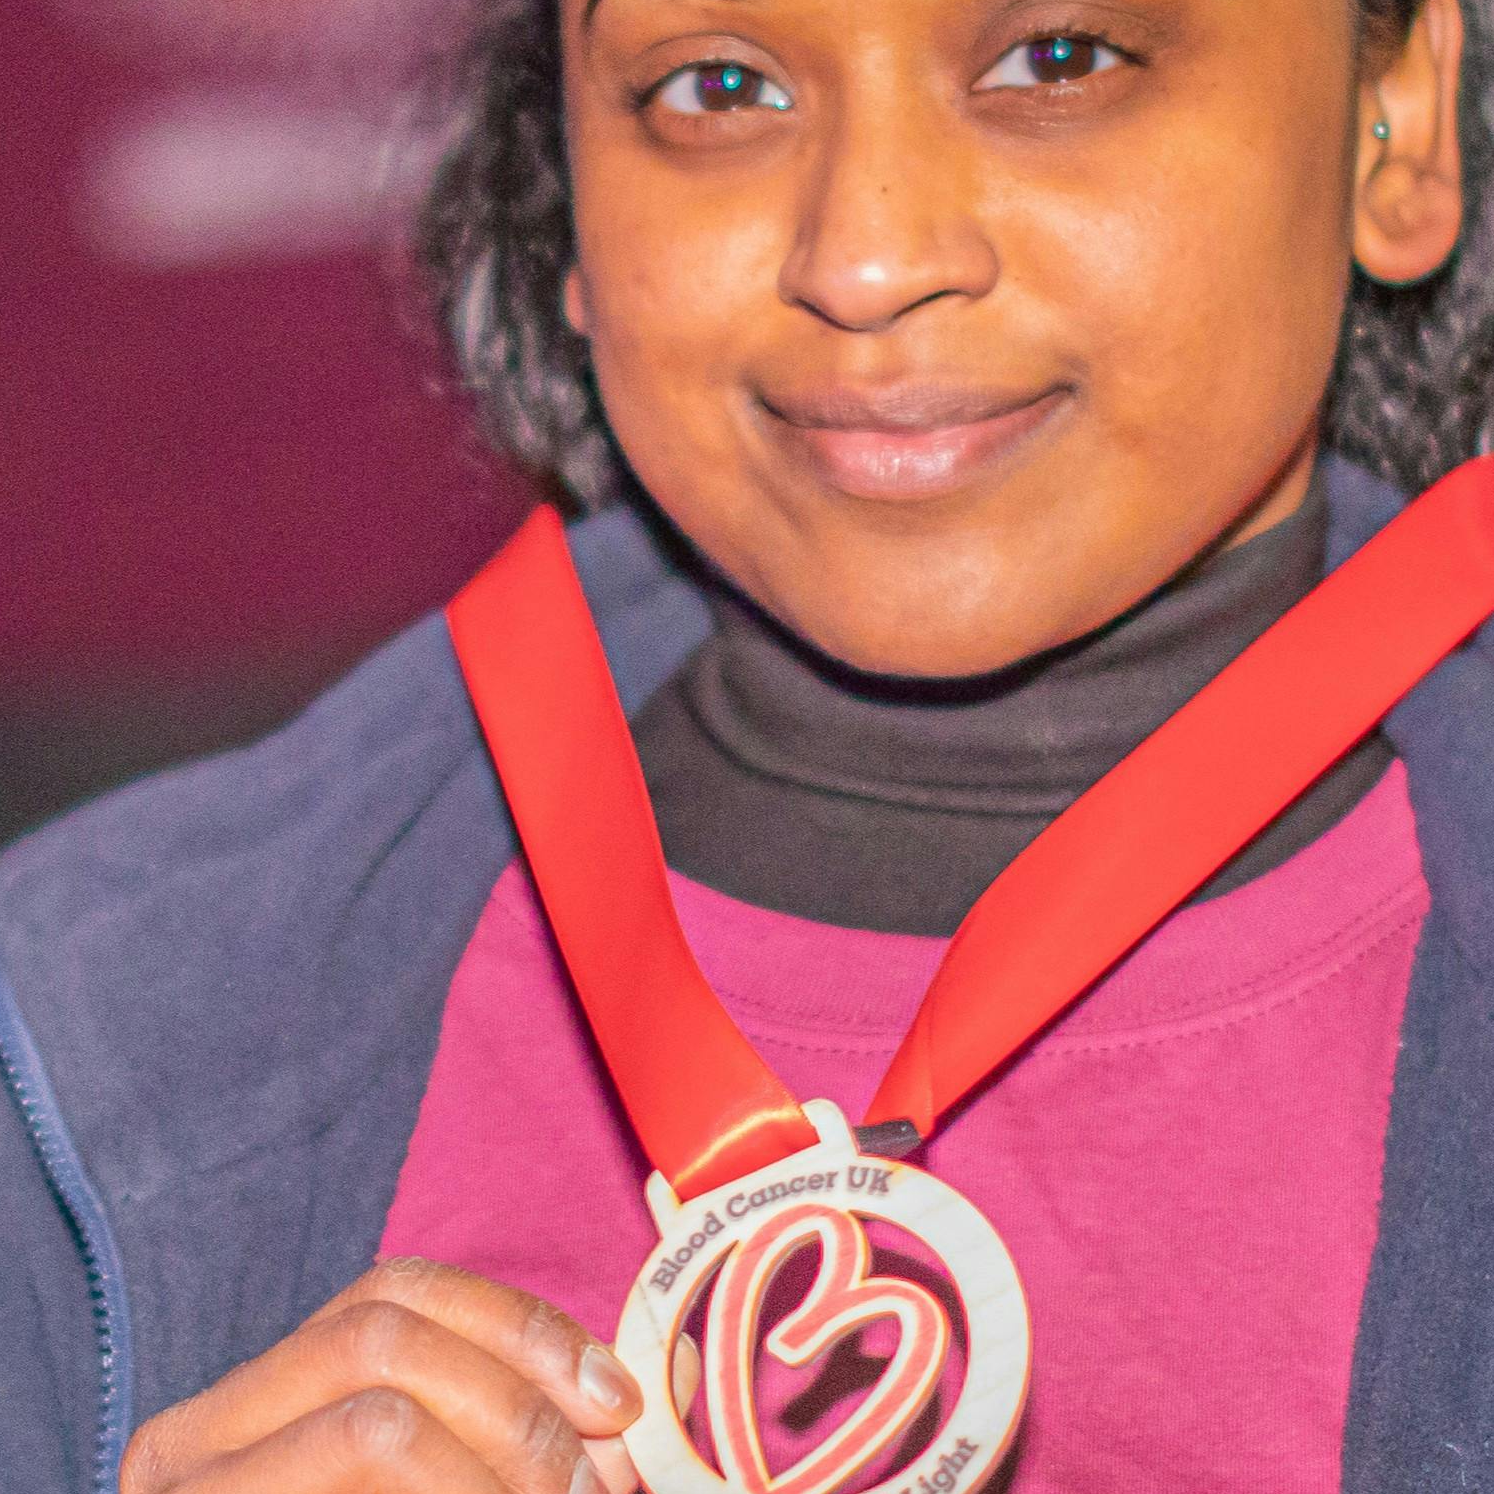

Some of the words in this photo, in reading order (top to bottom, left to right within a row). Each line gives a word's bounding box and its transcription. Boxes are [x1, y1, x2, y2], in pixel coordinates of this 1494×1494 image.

[650, 1213, 725, 1294] Blood
[725, 1168, 838, 1218] Cancer
[846, 1165, 894, 1196] UK
